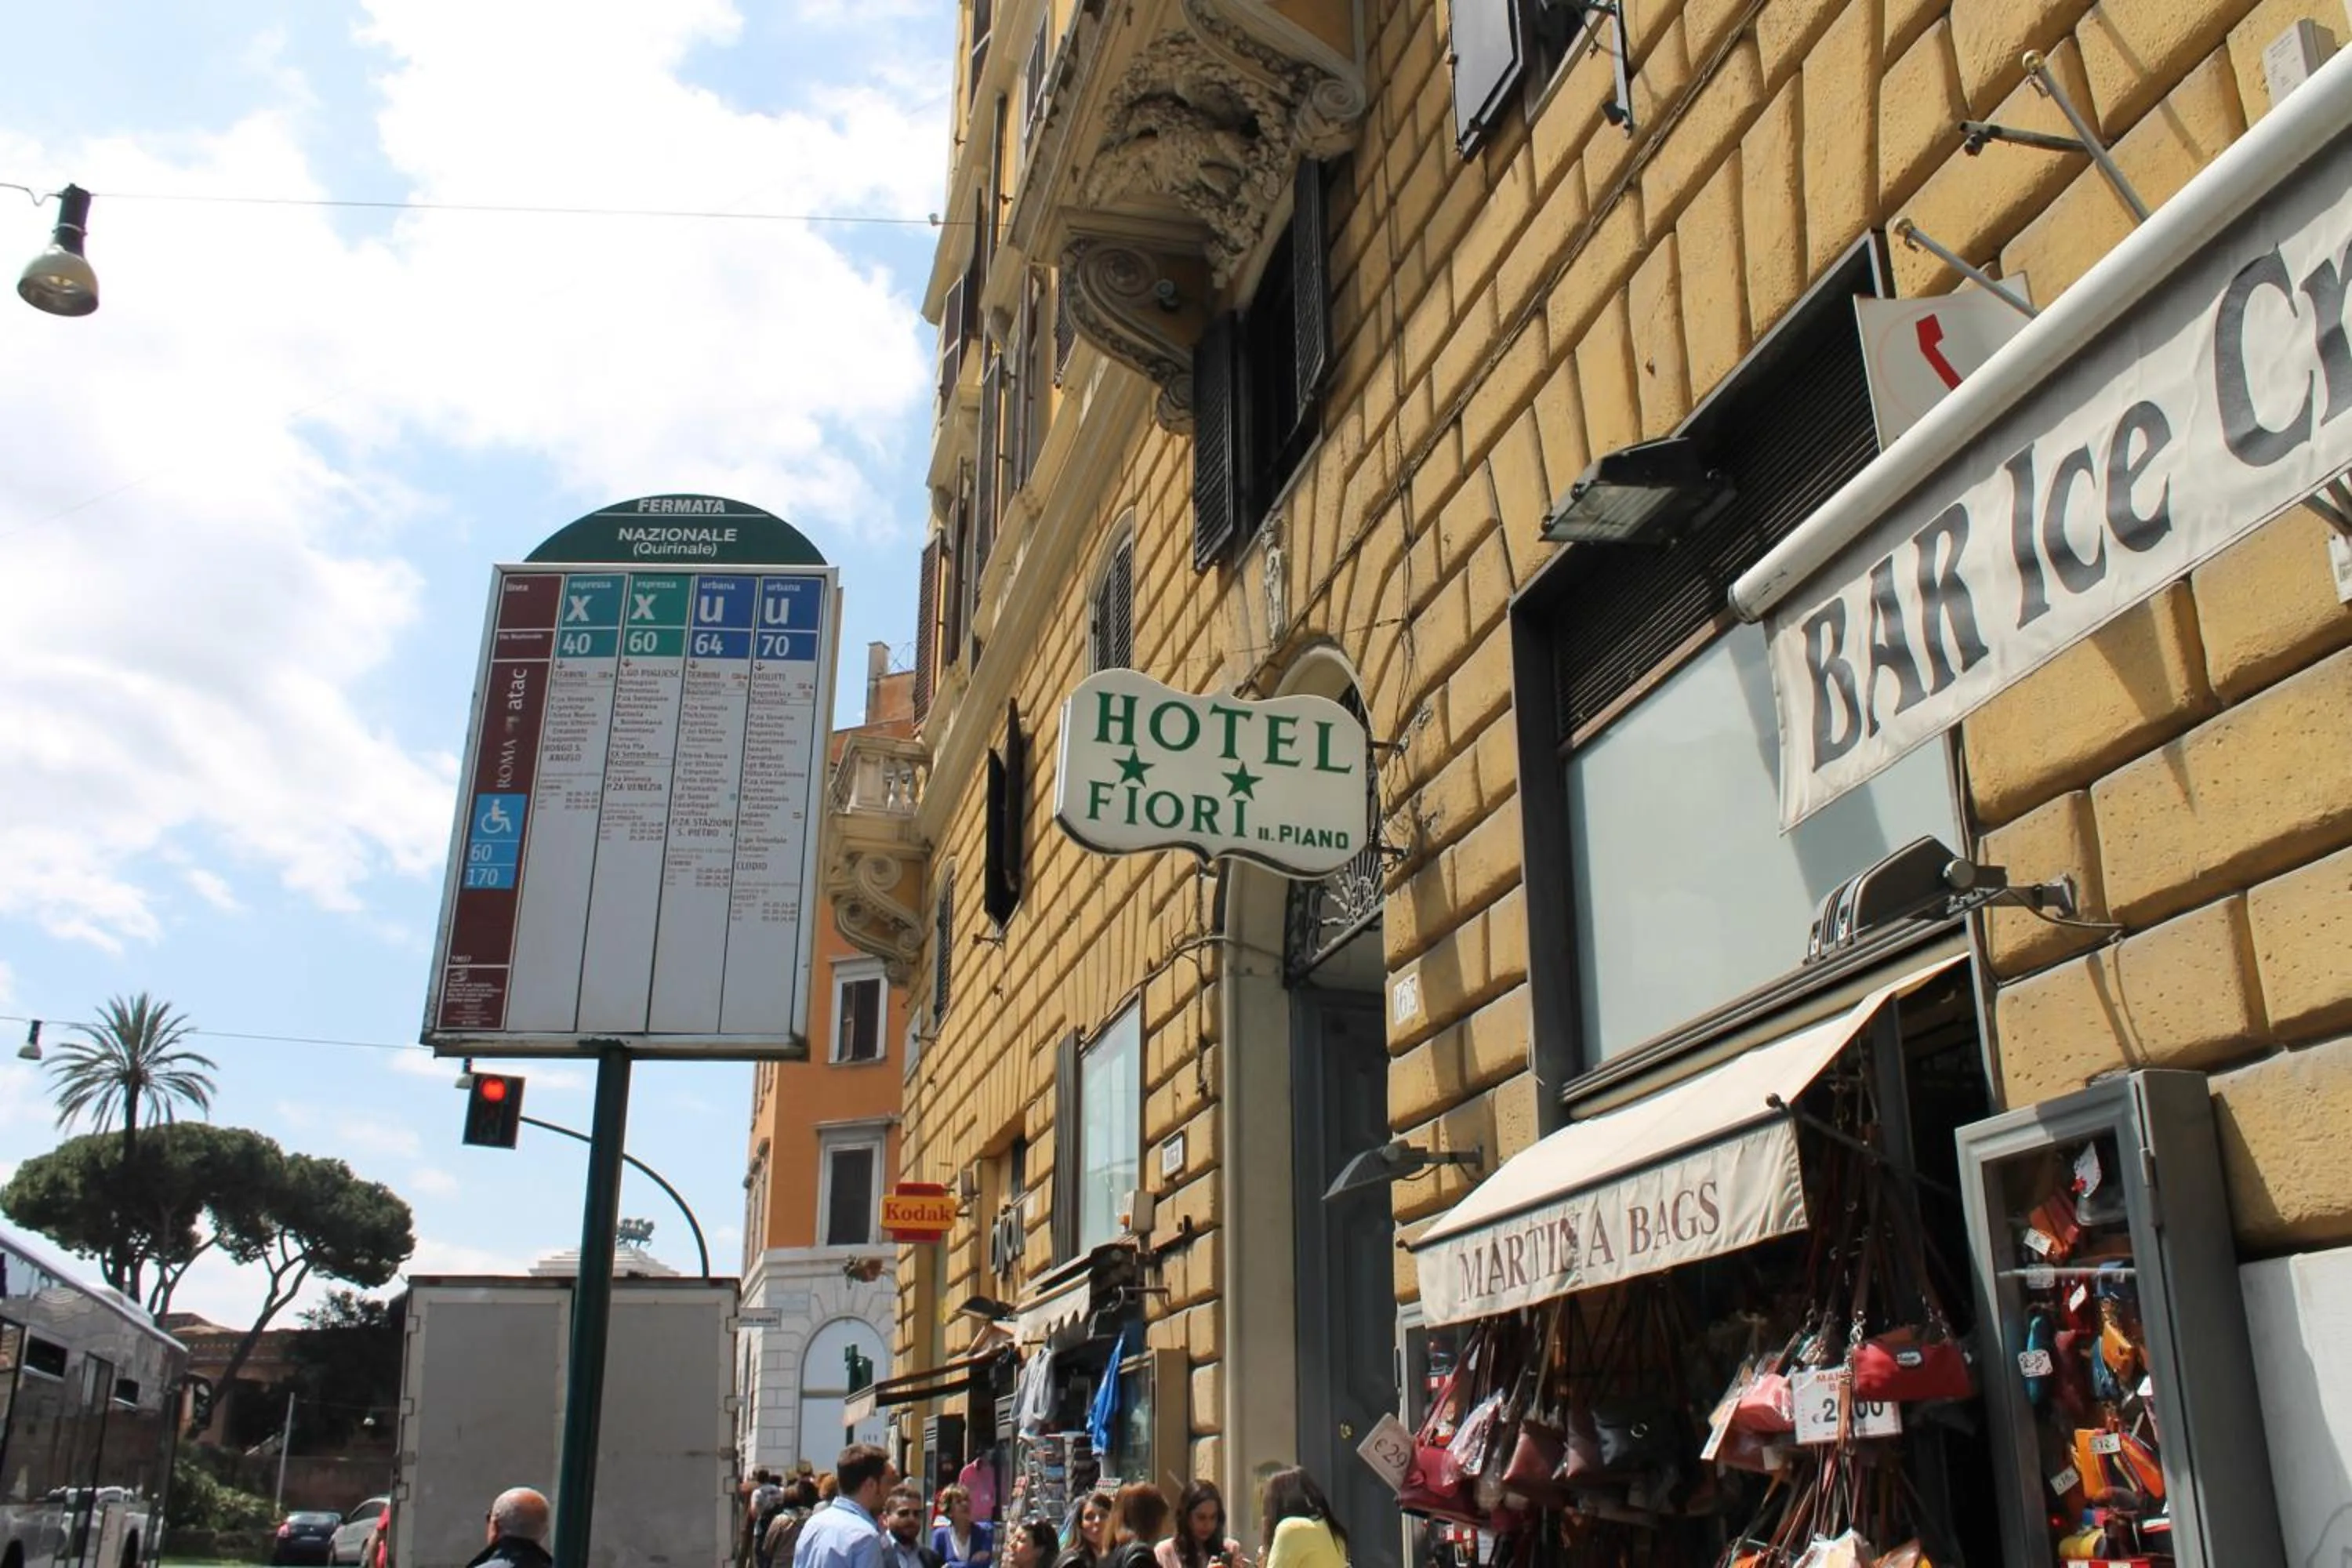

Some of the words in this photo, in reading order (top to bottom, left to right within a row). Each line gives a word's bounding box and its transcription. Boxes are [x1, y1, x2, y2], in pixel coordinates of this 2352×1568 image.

[637, 499, 726, 514] FERMATA
[618, 528, 738, 542] NAZIONALE
[633, 543, 718, 557] (Quirinale)
[1801, 502, 1989, 773] BAR
[2005, 400, 2172, 630] Ice
[562, 633, 591, 655] 40
[629, 631, 657, 652] 60
[695, 634, 724, 655] 64
[762, 636, 789, 656] 70
[507, 668, 528, 710] atac
[1094, 691, 1353, 774] HOTEL
[496, 739, 517, 789] ROMA
[1086, 780, 1248, 838] FIORI
[1279, 824, 1350, 850] PIANO
[470, 844, 492, 862] 60
[467, 868, 499, 886] 170
[886, 1203, 953, 1221] Kodak
[1458, 1201, 1616, 1303] MARTINA
[1627, 1180, 1721, 1255] BAGS
